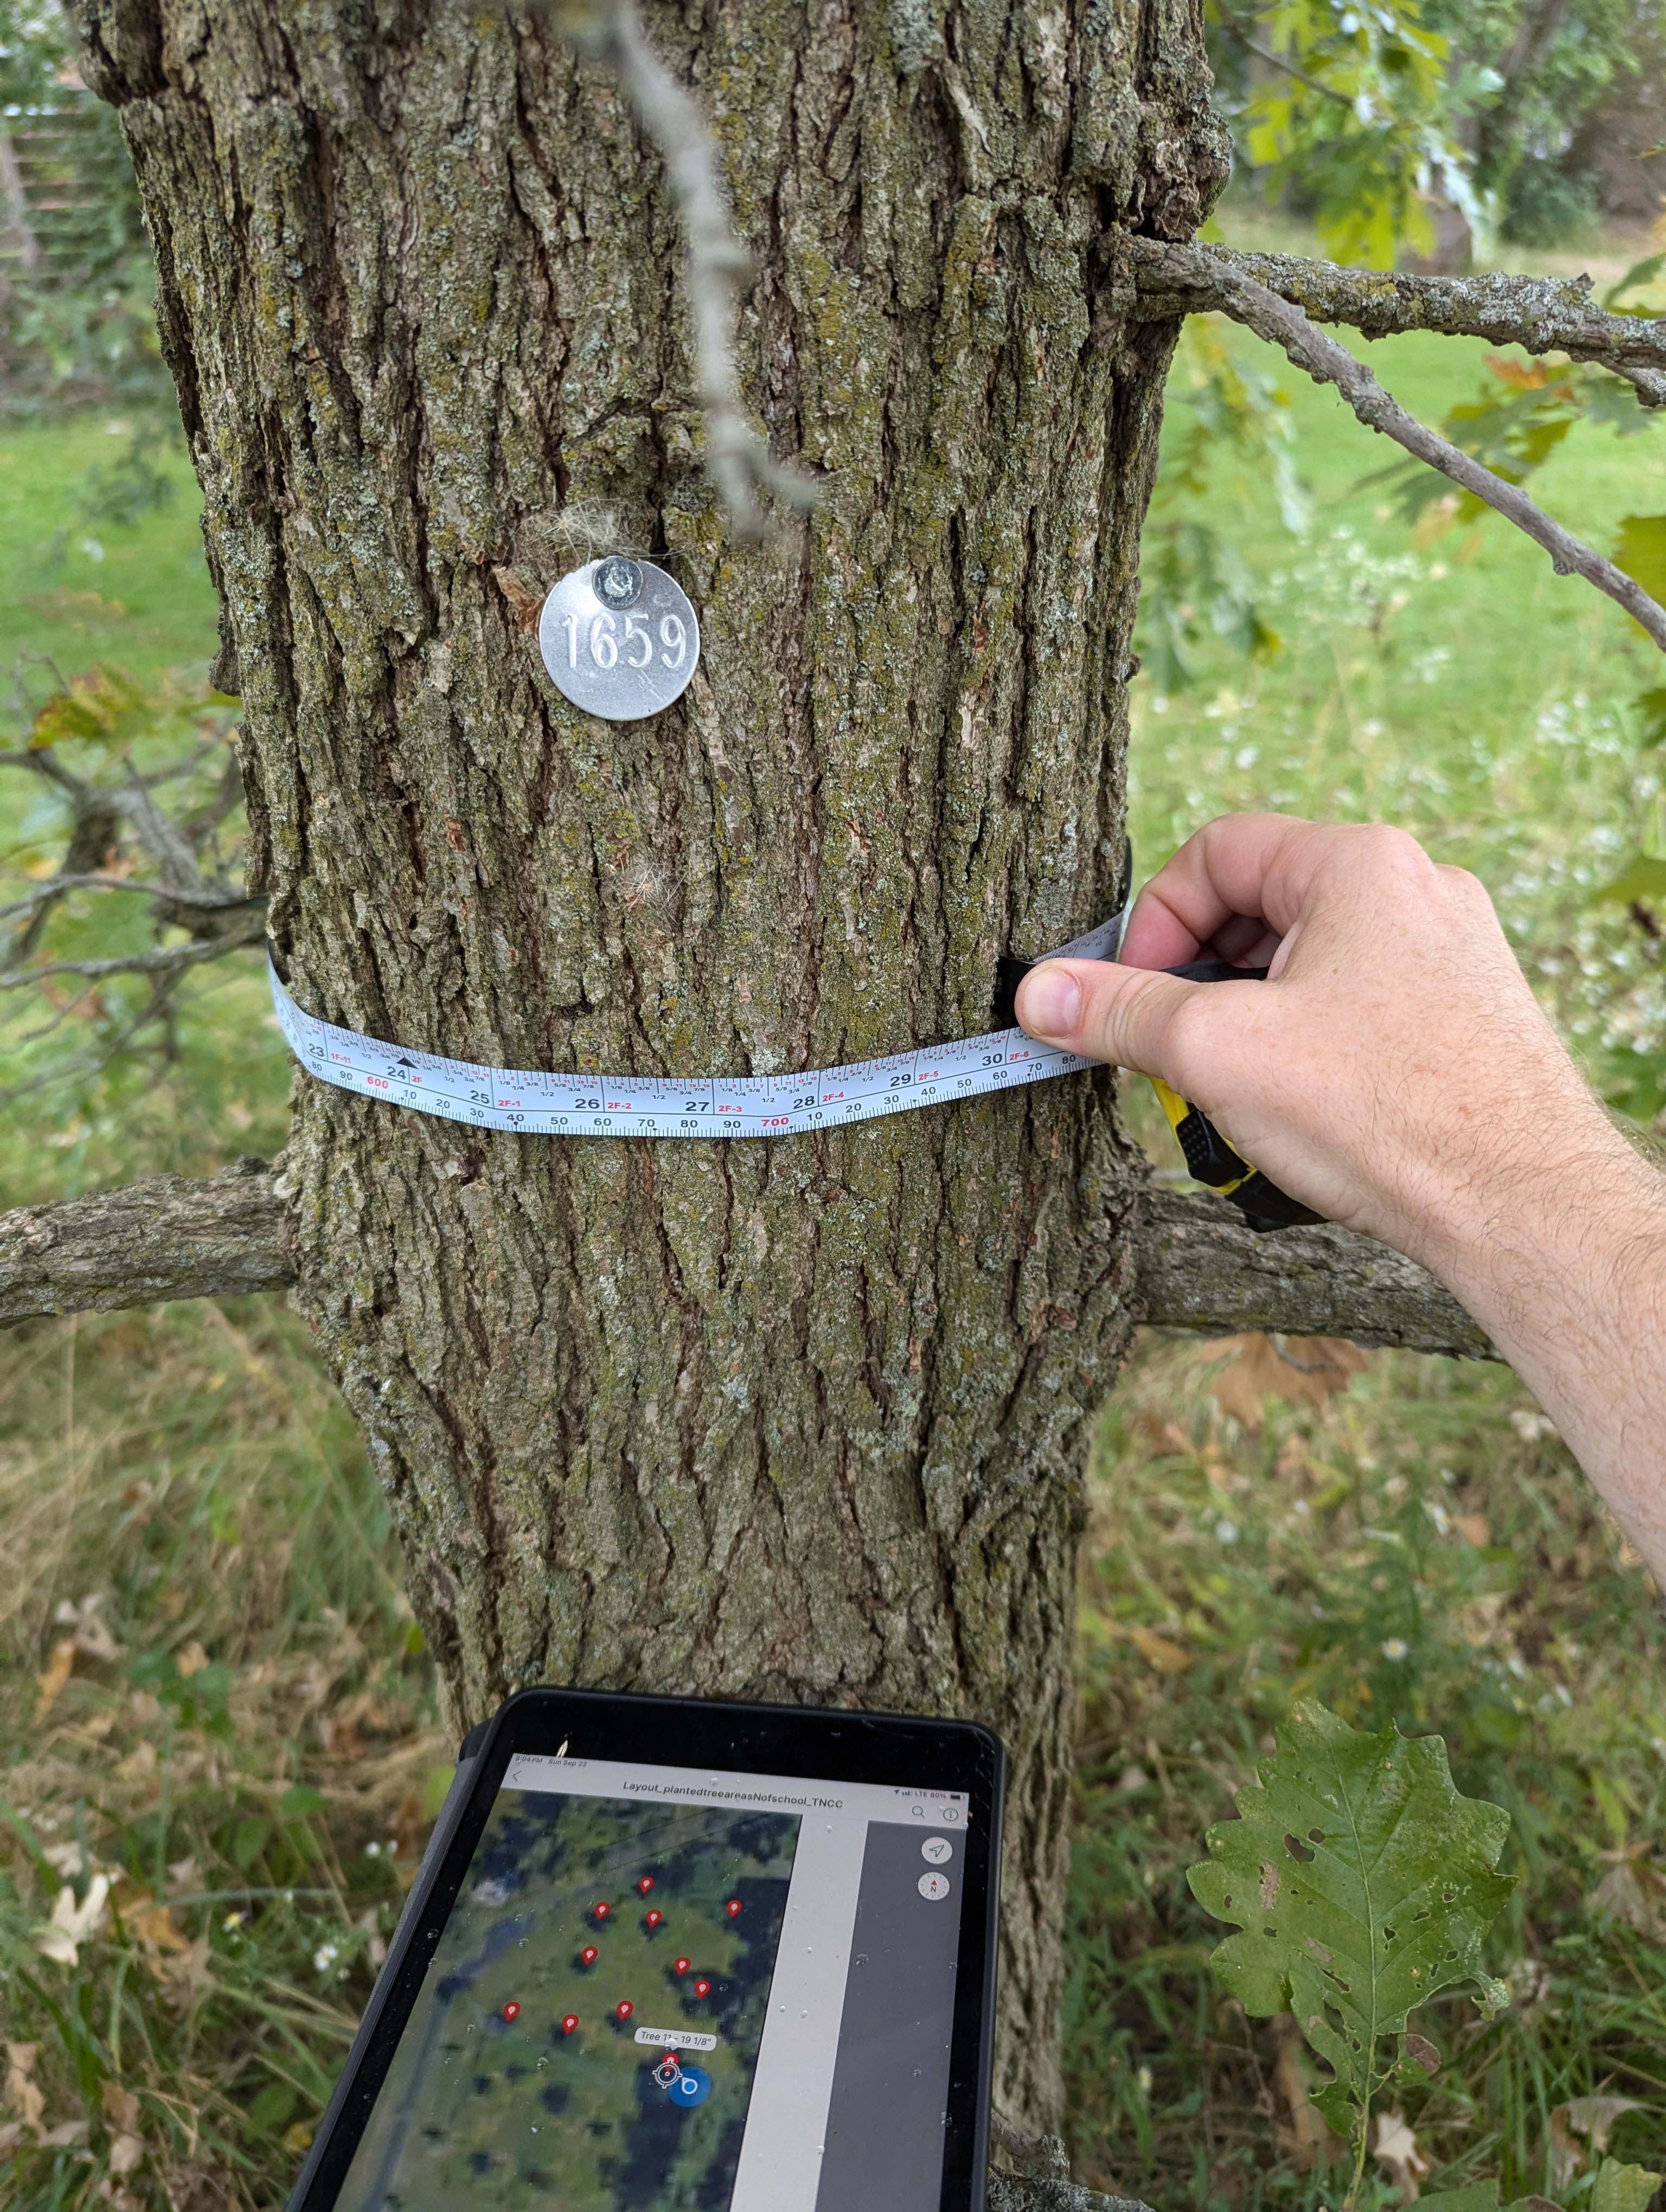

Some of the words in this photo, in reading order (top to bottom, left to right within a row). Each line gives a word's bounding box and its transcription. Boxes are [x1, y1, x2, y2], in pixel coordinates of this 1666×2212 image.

[562, 613, 686, 668] 1659
[309, 1043, 324, 1057] 23
[331, 1053, 351, 1063] 1F-11
[387, 1066, 406, 1079] 24
[471, 1090, 490, 1104] 25
[575, 1098, 600, 1109] 26
[685, 1102, 709, 1111] 27
[793, 1096, 815, 1109] 28
[823, 1091, 844, 1102] 2F-4
[890, 1073, 911, 1087] 29
[919, 1071, 939, 1081] 2F-5
[982, 1053, 1003, 1066] 30
[1009, 1051, 1029, 1060] 2F-6
[312, 1061, 322, 1071] 80
[340, 1071, 353, 1080] 90
[367, 1076, 388, 1089] 600
[404, 1090, 416, 1099] 10
[436, 1099, 450, 1109] 20
[470, 1108, 484, 1118] 30
[551, 1117, 568, 1125] 50
[594, 1118, 612, 1126] 60
[638, 1119, 655, 1127] 70
[761, 1117, 789, 1127] 700
[807, 1112, 822, 1121] 10
[845, 1103, 861, 1113] 20
[884, 1095, 899, 1104] 30
[921, 1086, 936, 1096] 40
[957, 1078, 972, 1088] 50
[993, 1070, 1008, 1080] 60
[1028, 1063, 1042, 1072] 70
[1062, 1055, 1075, 1064] 80
[623, 1781, 843, 1808] Layout_plantedtreeareasNofschool_TNCC
[642, 2031, 660, 2040] Tree
